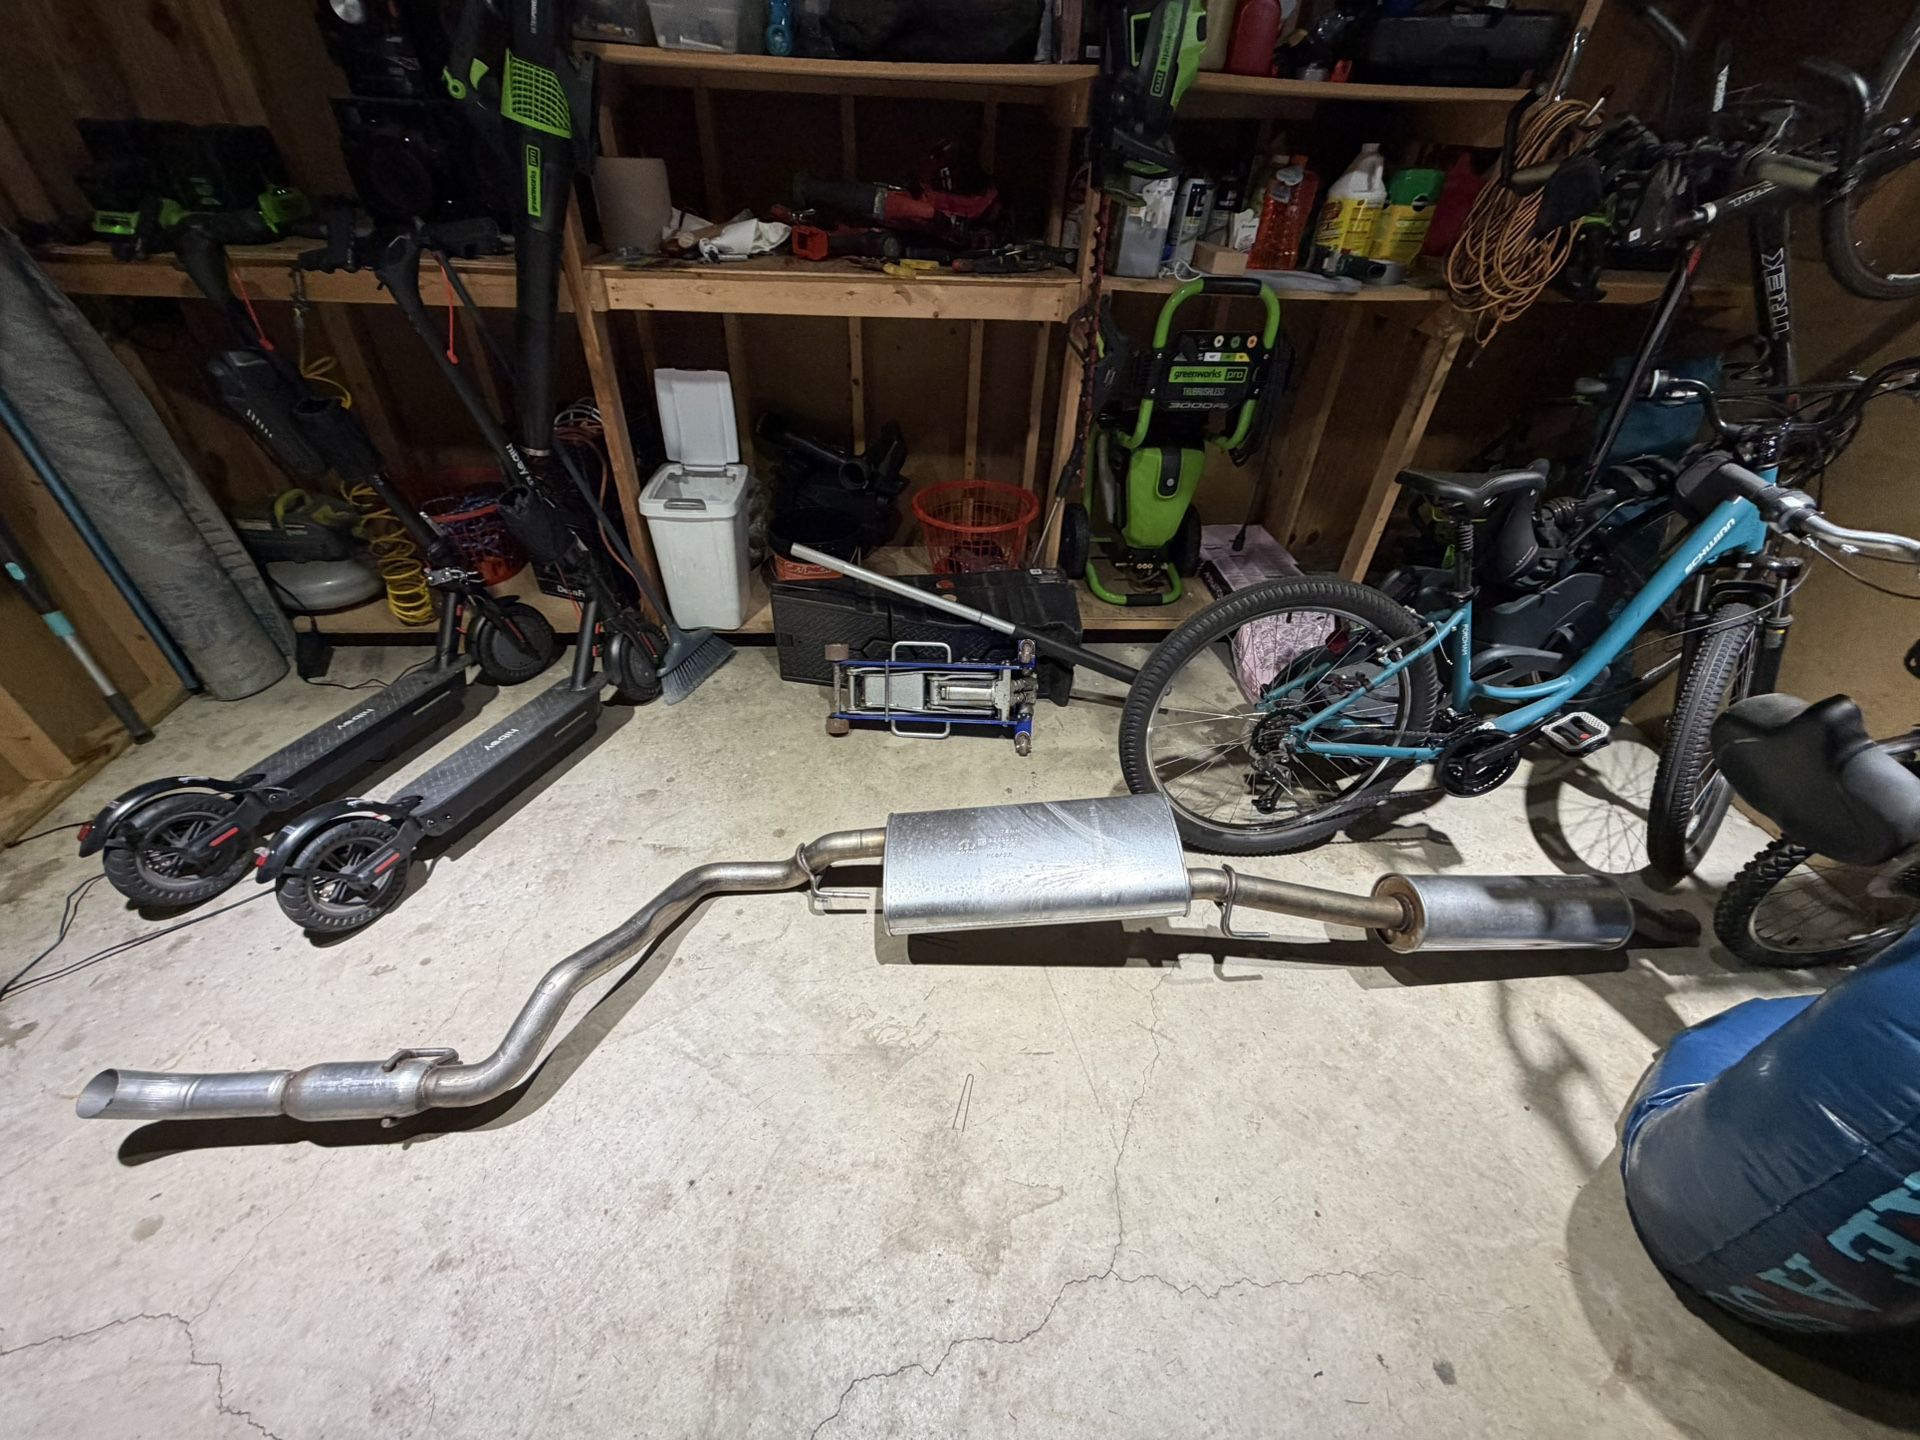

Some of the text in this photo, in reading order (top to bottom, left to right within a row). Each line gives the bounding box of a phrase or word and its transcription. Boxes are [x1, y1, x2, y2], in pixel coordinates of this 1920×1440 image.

[1760, 247, 1790, 335] TREK
[1173, 369, 1244, 380] greenworks pro
[1684, 518, 1735, 575] SCHWINN
